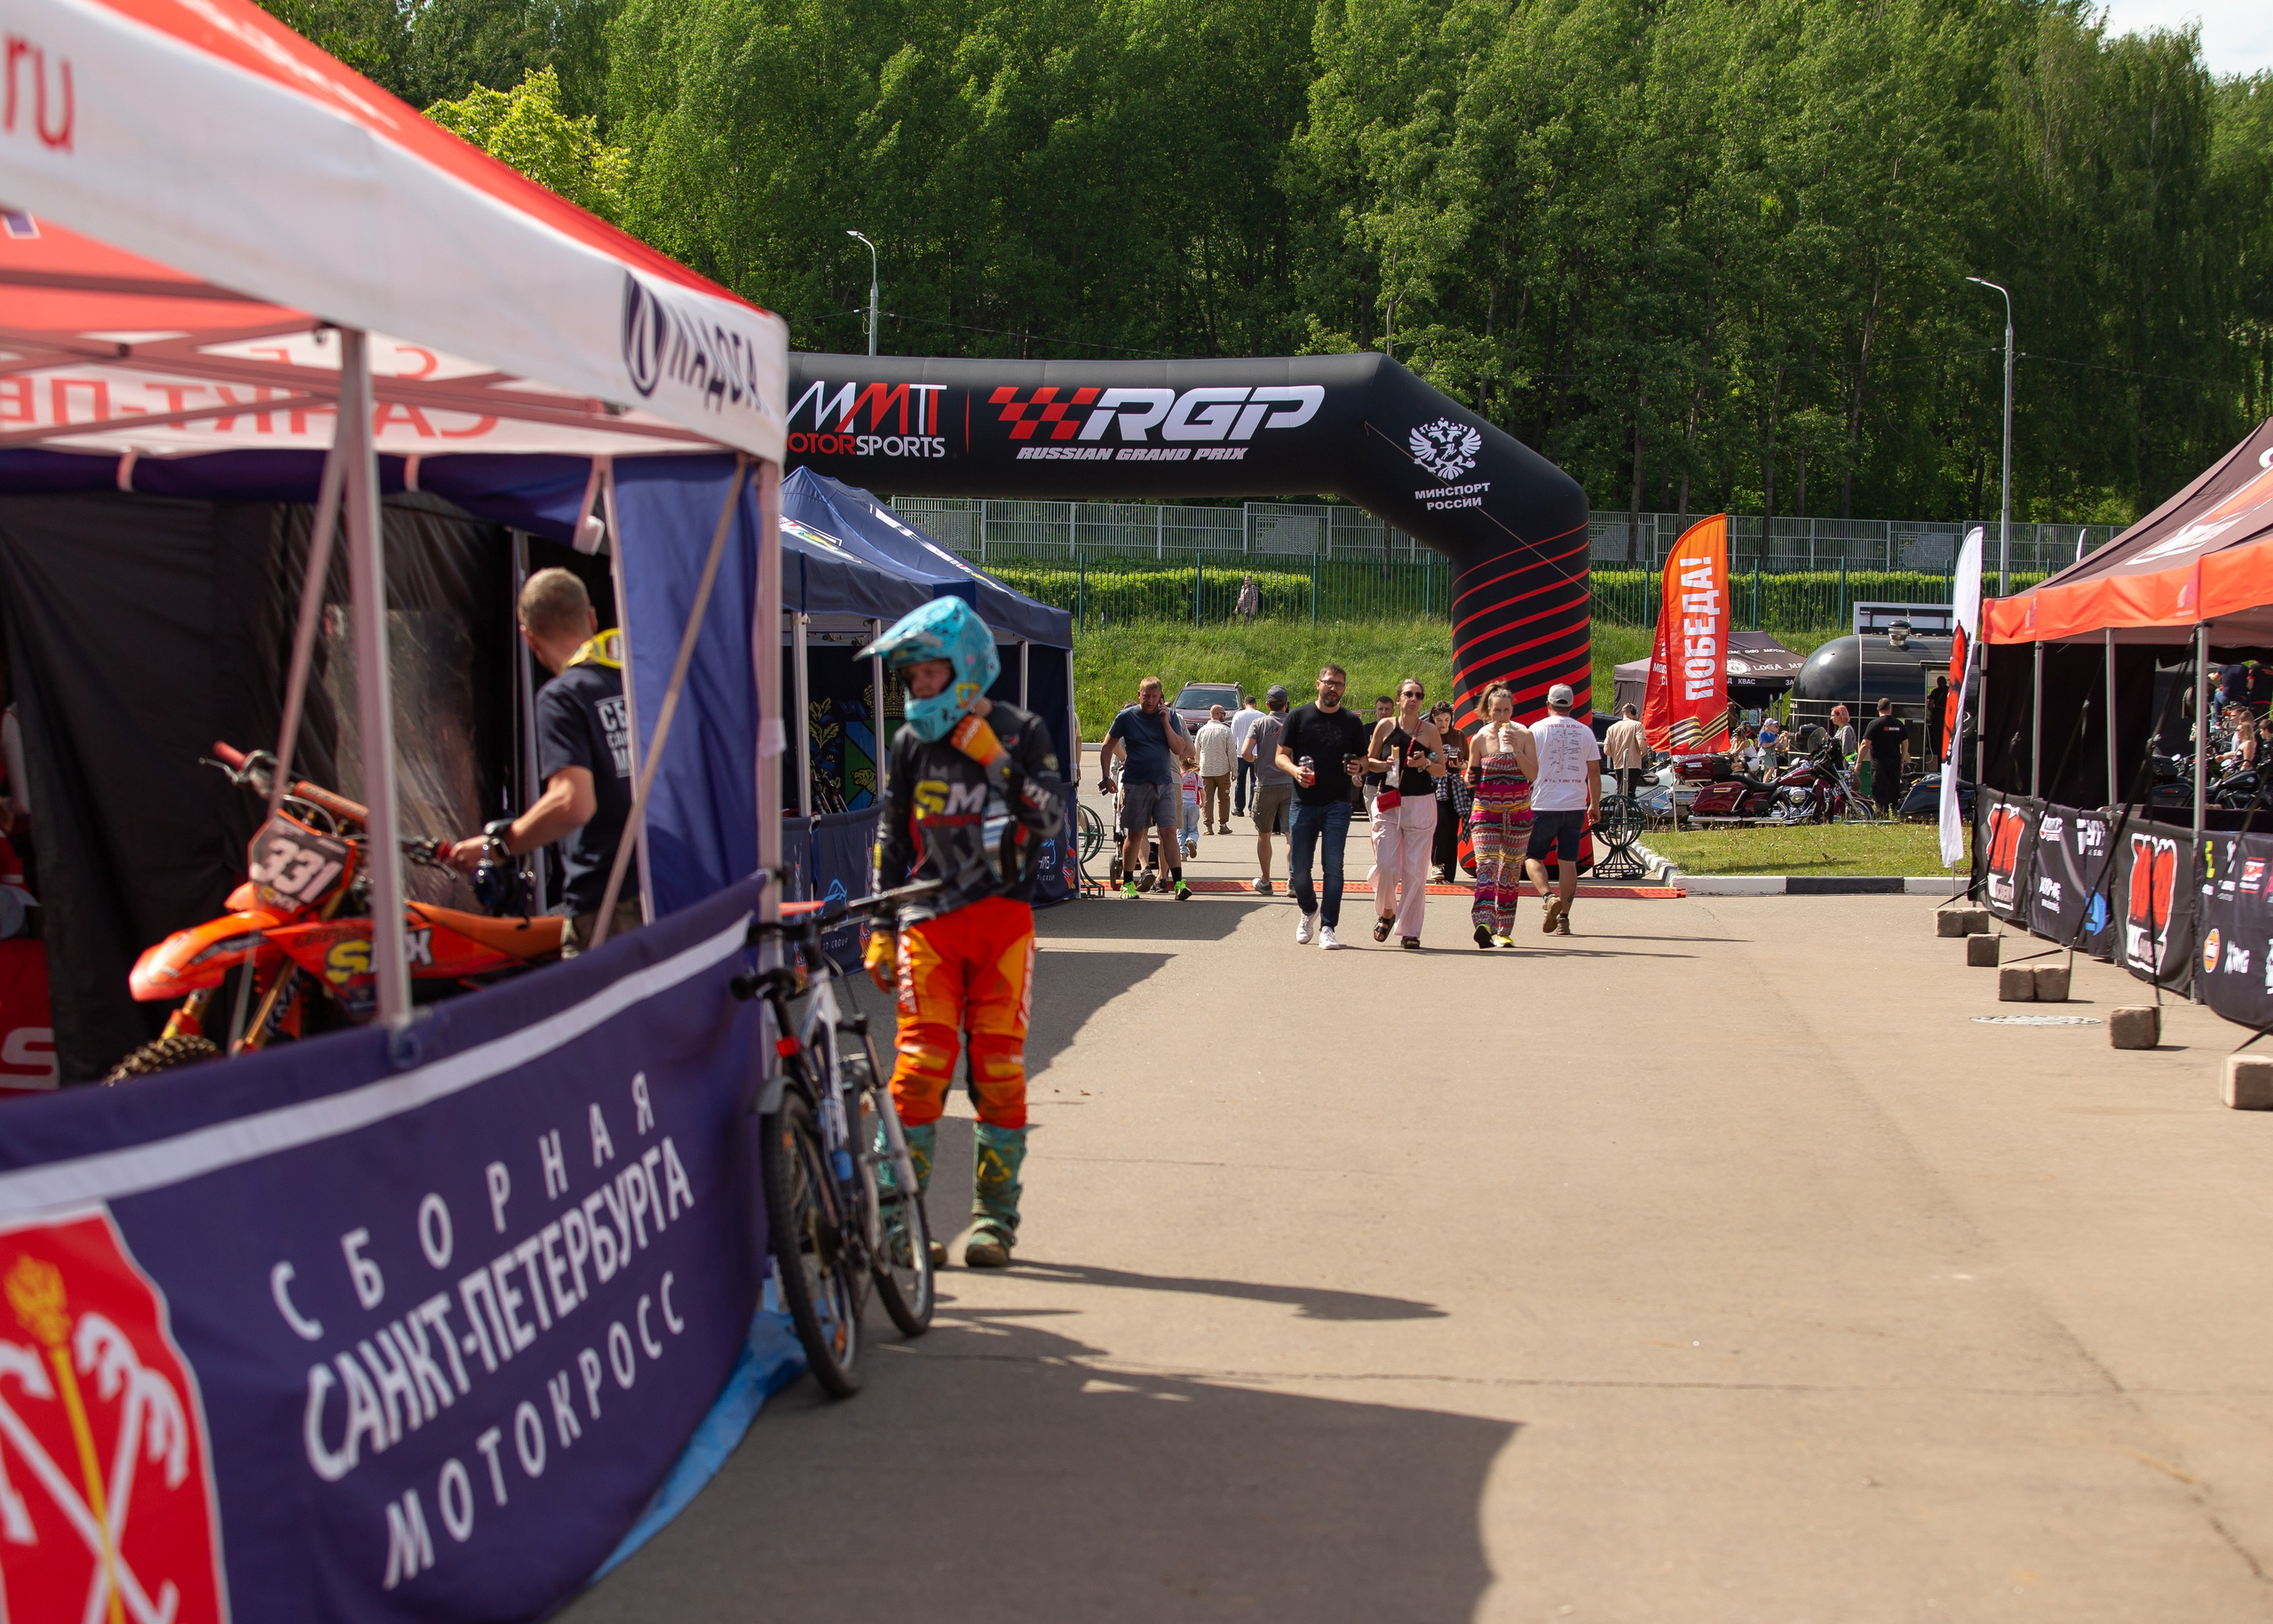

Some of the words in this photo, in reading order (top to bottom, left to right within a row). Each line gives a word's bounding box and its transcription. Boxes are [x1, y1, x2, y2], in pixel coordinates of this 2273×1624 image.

[1078, 385, 1325, 440] RGP
[786, 432, 945, 457] OTORSPORTS
[1017, 447, 1113, 461] RUSSIAN
[1115, 448, 1191, 461] GRAND
[1192, 448, 1248, 461] PRIX
[1414, 482, 1491, 499] МИНСПОРТ
[1426, 497, 1482, 511] РОССИИ
[1679, 556, 1721, 701] ПОБЕДА!
[251, 837, 344, 904] 331
[303, 1136, 694, 1481] САНКТ-ПЕТЕРБУРГА
[382, 1271, 685, 1590] МОТОКРОСС
